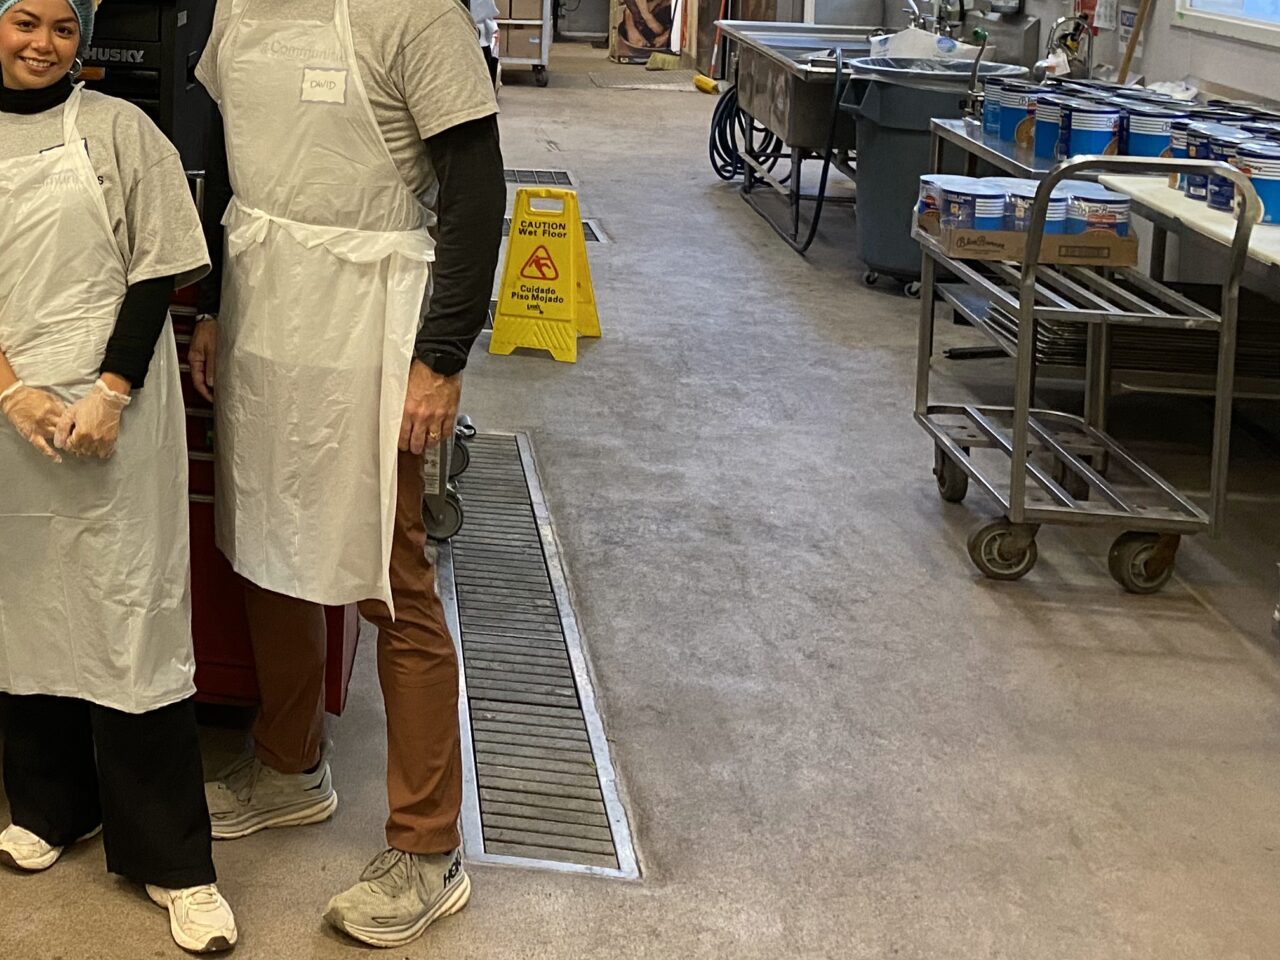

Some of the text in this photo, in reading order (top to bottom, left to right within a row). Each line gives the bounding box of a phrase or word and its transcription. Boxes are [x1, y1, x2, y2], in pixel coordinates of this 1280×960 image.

[82, 47, 145, 63] HUSKY
[310, 79, 337, 90] DAVID
[520, 220, 566, 230] CAUTION
[518, 227, 567, 238] Wet Floor
[520, 284, 556, 295] Cuidado
[511, 291, 564, 304] Piso Mojado
